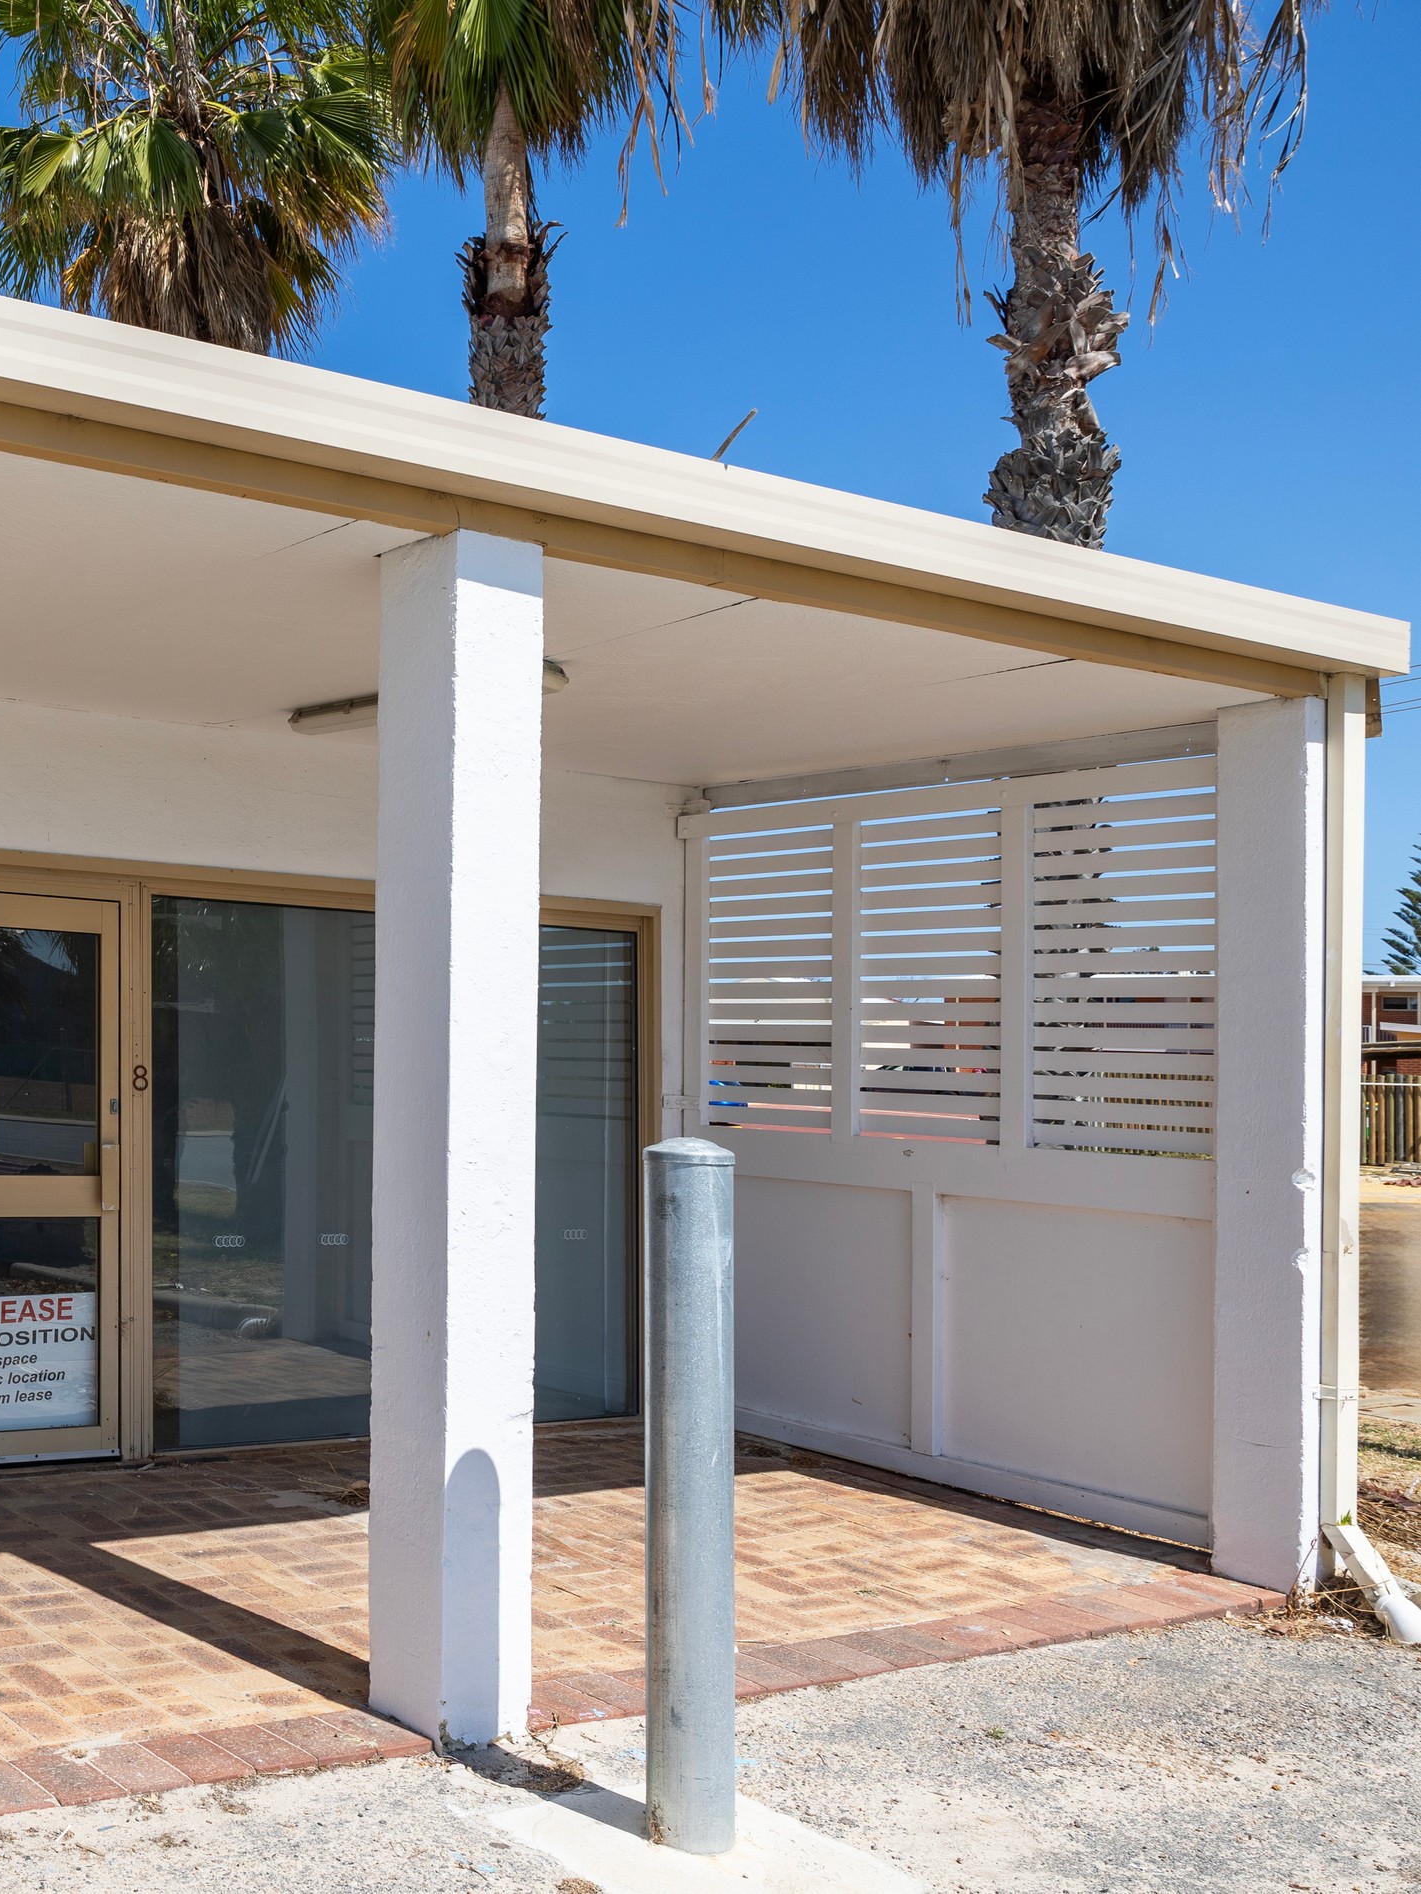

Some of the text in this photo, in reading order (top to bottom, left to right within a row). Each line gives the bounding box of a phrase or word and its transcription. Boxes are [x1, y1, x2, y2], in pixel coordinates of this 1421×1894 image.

[132, 1064, 149, 1091] 8
[7, 1369, 66, 1385] location
[14, 1389, 53, 1403] lease
